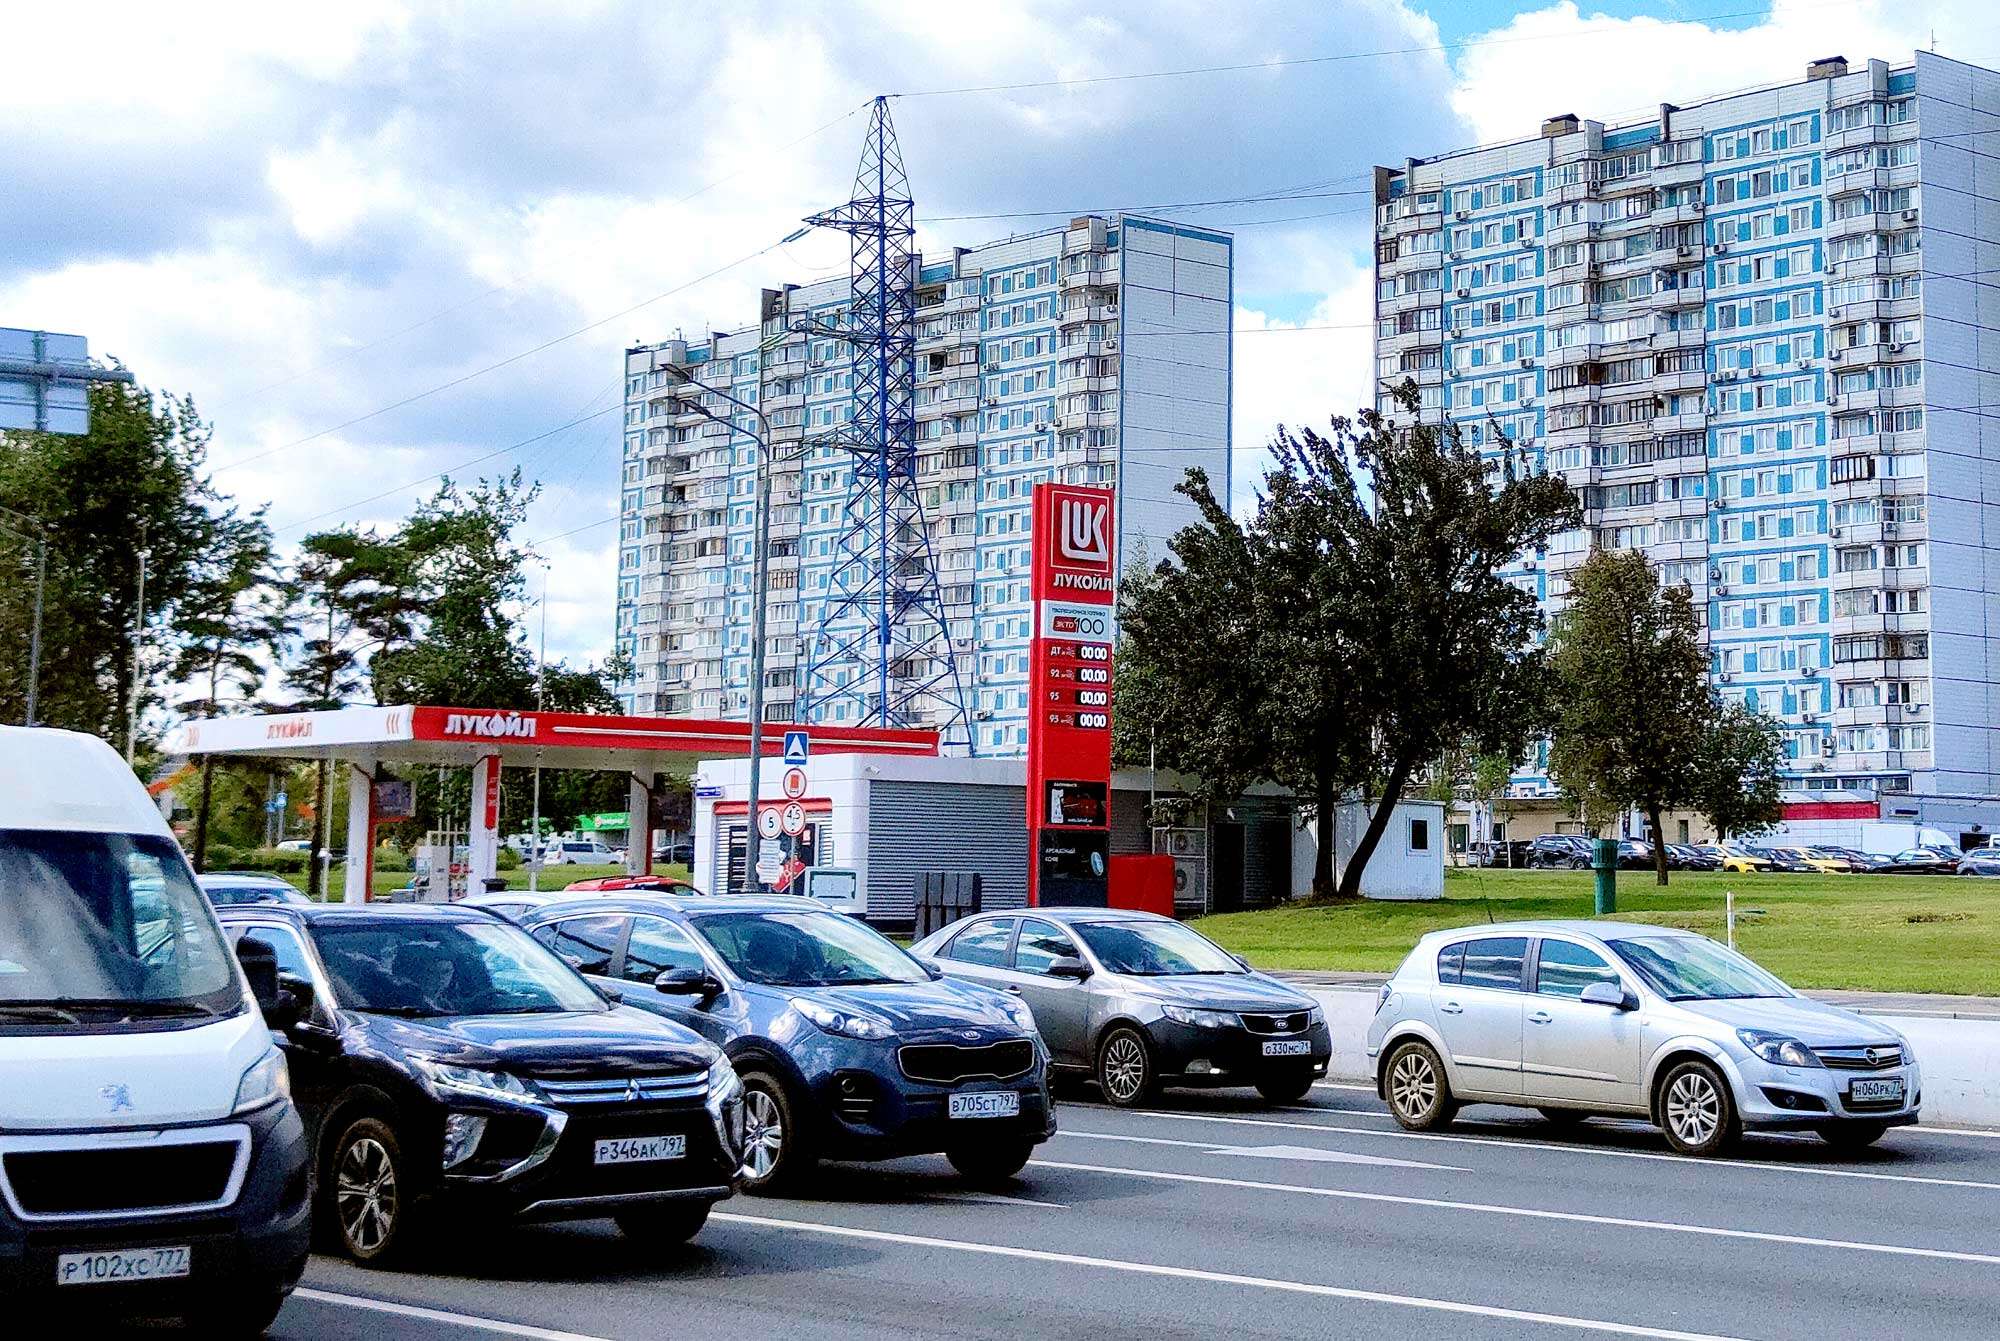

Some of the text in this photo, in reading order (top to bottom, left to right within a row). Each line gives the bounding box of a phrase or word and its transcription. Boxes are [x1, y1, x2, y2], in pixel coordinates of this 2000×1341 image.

[1053, 572, 1112, 591] ЛУКОЙЛ
[1075, 617, 1105, 635] 100
[1050, 646, 1061, 656] ДТ
[1050, 669, 1060, 678] 92
[1049, 692, 1060, 701] 95
[444, 711, 537, 738] ЛУКОЙЛ
[1049, 714, 1059, 723] 95
[267, 717, 312, 740] ЛУКОЙЛ
[768, 816, 774, 829] 5
